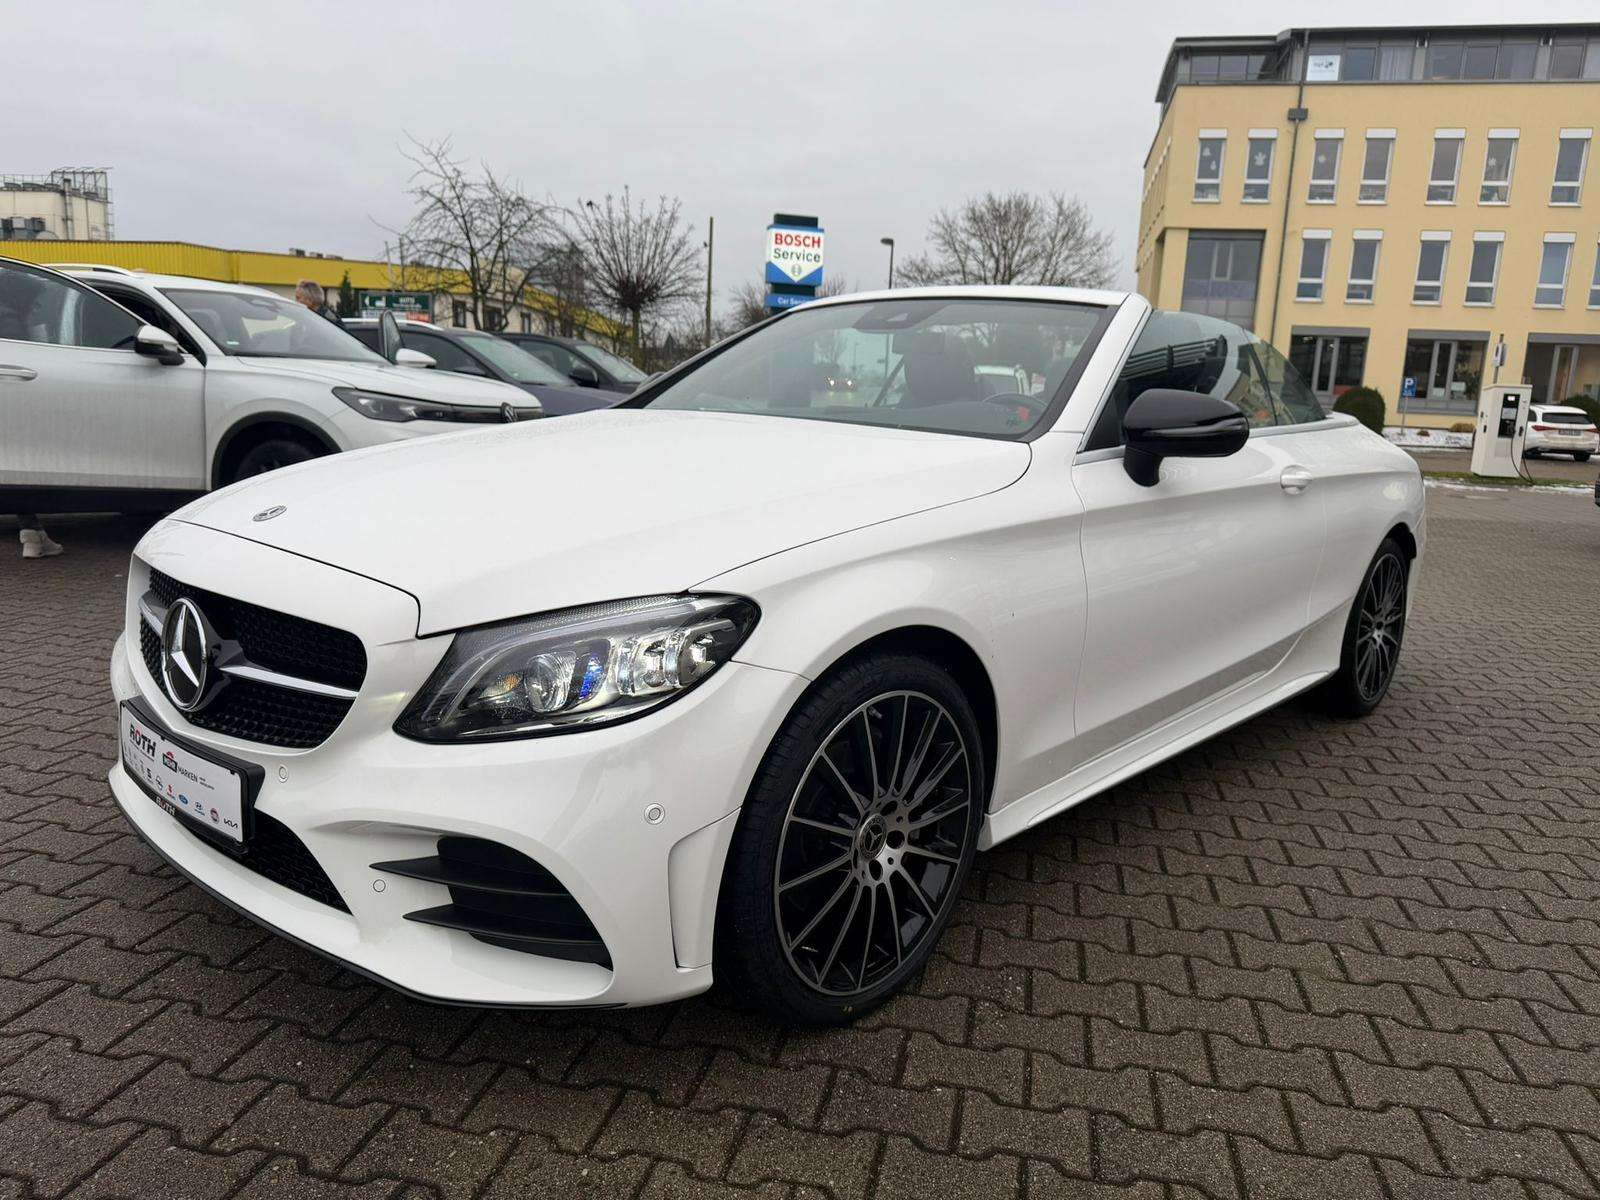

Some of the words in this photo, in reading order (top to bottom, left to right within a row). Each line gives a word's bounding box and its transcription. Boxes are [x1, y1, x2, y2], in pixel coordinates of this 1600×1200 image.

[774, 233, 821, 249] BOSCH
[773, 247, 821, 263] Service
[1404, 377, 1414, 389] P
[129, 724, 156, 756] ROTH
[178, 766, 198, 782] MARKEN
[155, 796, 176, 815] ROTH
